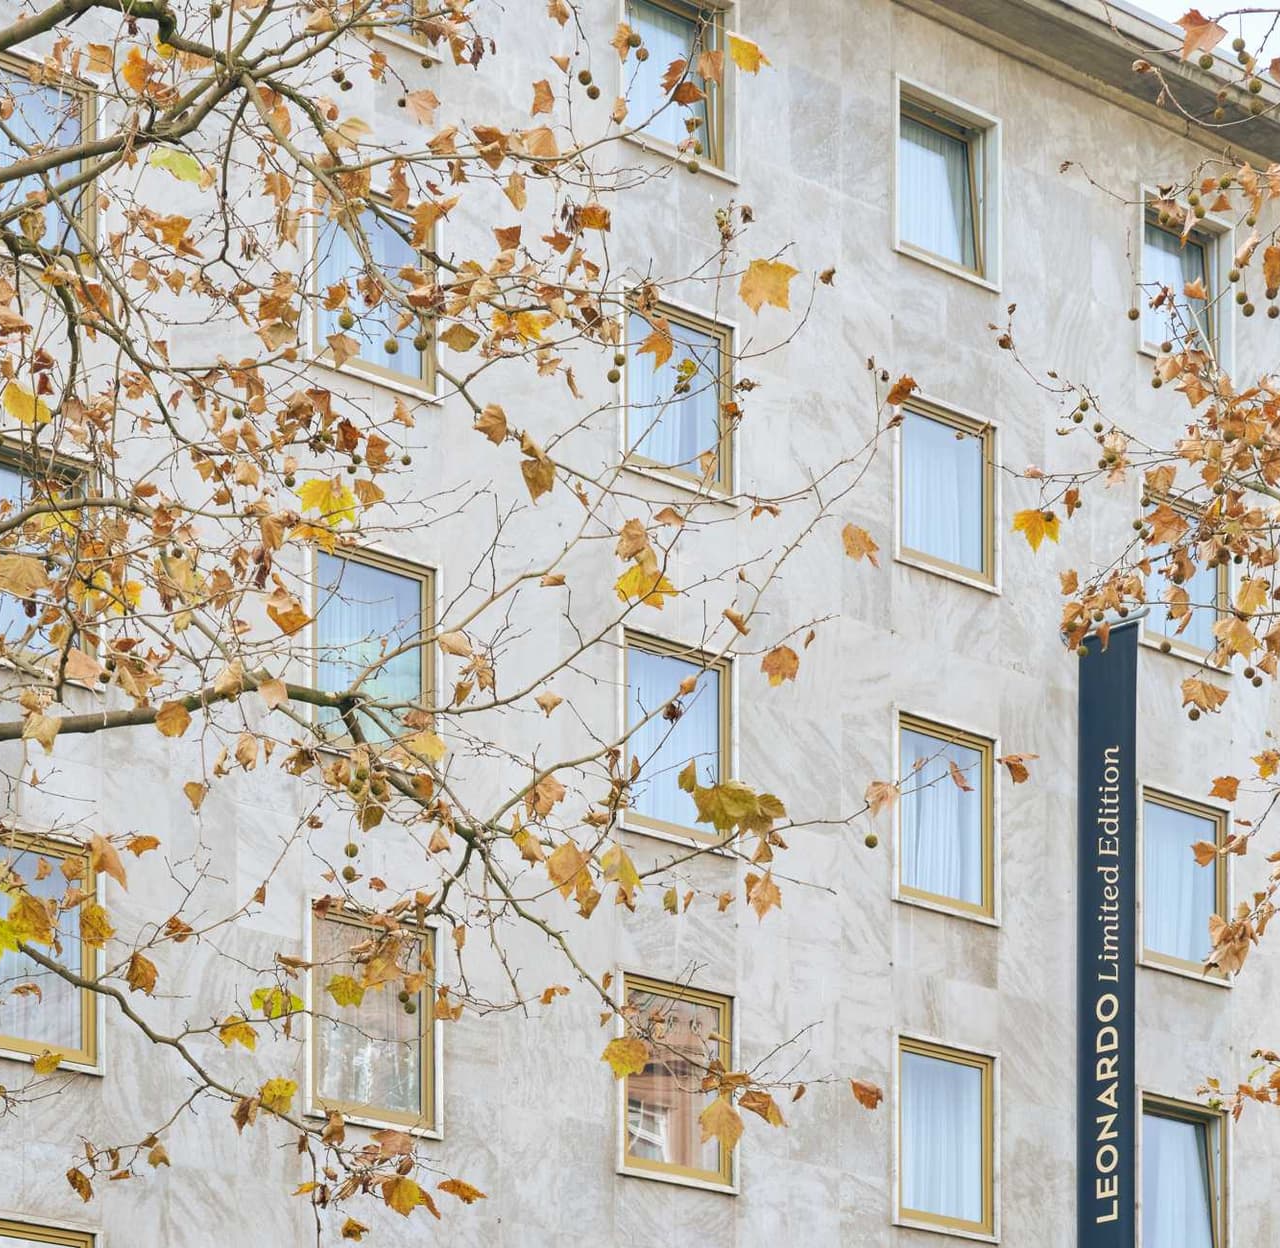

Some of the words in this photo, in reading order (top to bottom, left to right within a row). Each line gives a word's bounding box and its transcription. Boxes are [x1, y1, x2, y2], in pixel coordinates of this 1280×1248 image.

[1097, 744, 1120, 857] Edition
[1097, 863, 1120, 984] Limited
[1095, 992, 1119, 1224] LEONARDO
